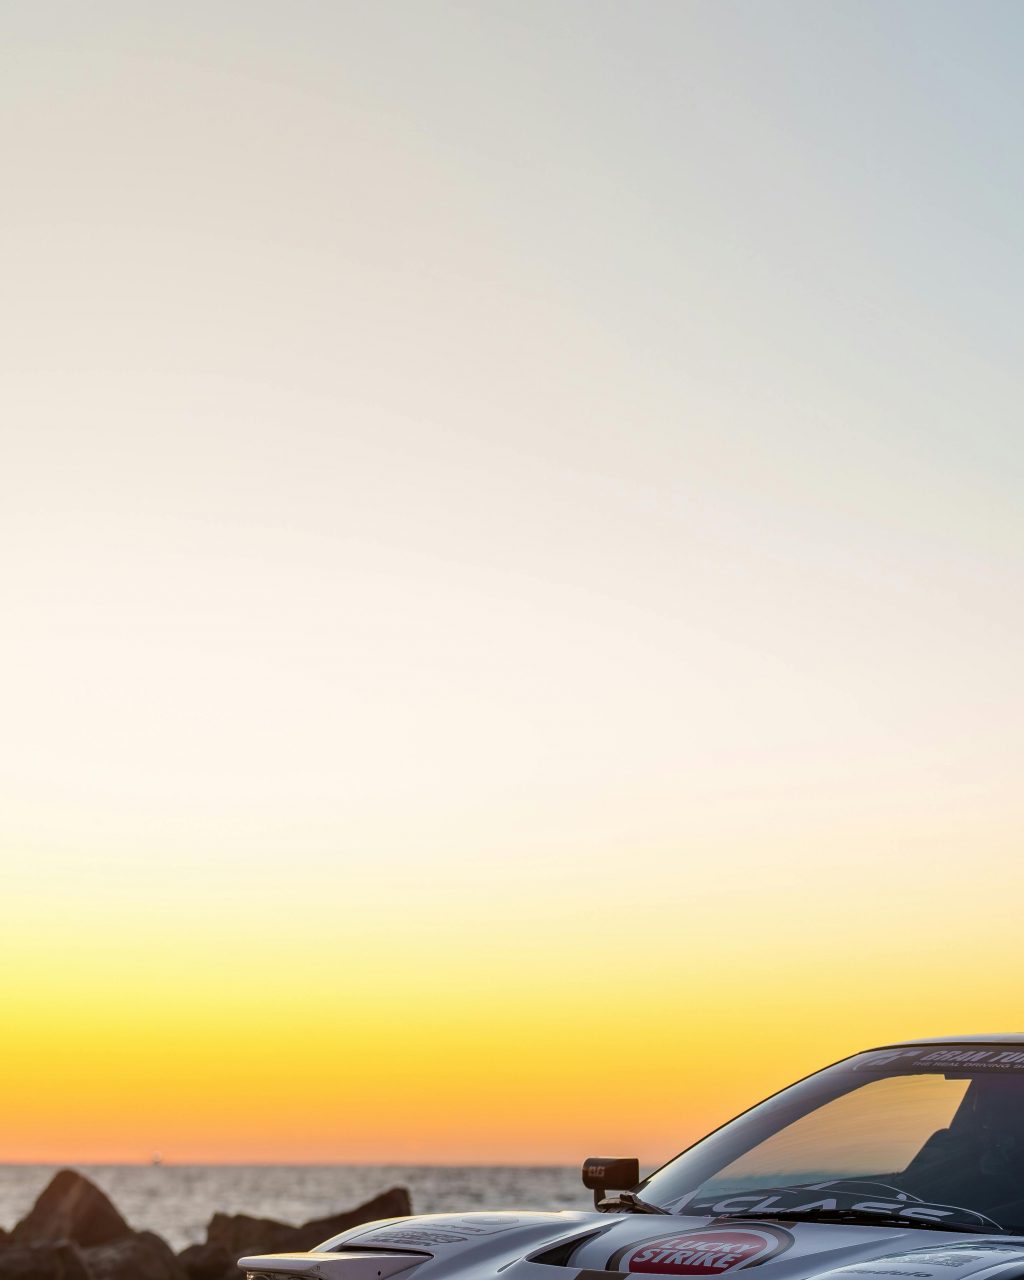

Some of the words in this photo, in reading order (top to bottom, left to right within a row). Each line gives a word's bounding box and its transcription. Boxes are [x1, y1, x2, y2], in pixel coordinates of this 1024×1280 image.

[920, 1050, 995, 1062] GRAN
[659, 1238, 762, 1253] LUCKY
[632, 1248, 744, 1269] STRIKE
